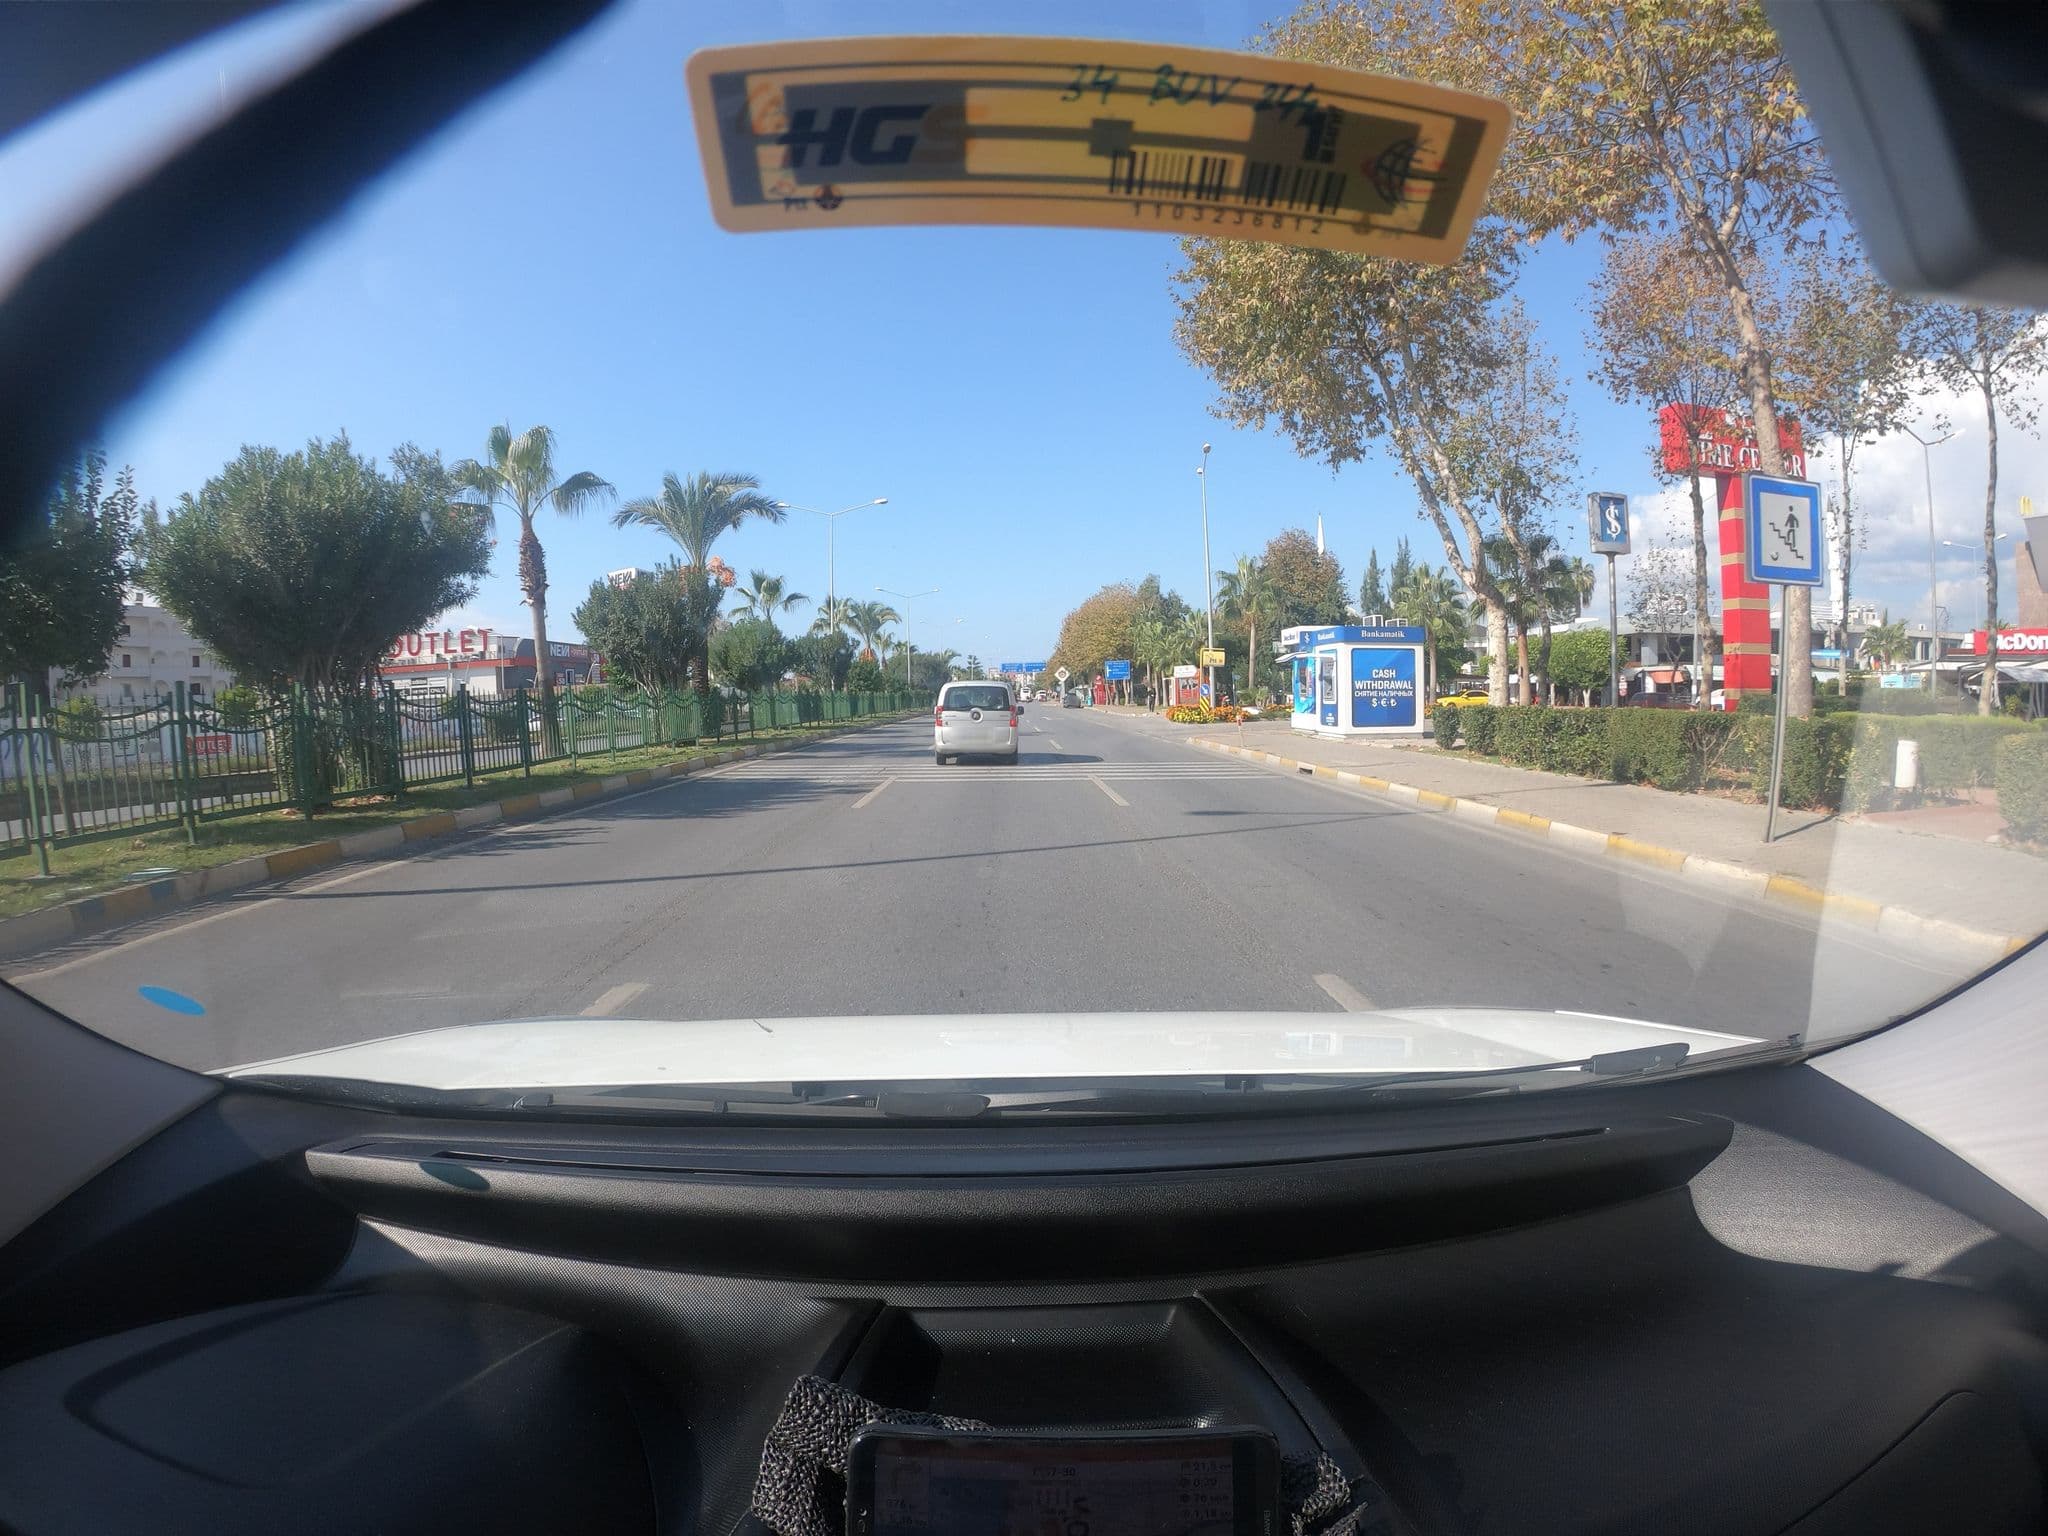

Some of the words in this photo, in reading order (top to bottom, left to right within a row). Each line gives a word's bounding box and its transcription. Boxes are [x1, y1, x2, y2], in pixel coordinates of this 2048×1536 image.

[1361, 629, 1405, 640] Bankamatik
[1372, 668, 1396, 679] CASH
[1354, 680, 1414, 690] WITHDRAWAL
